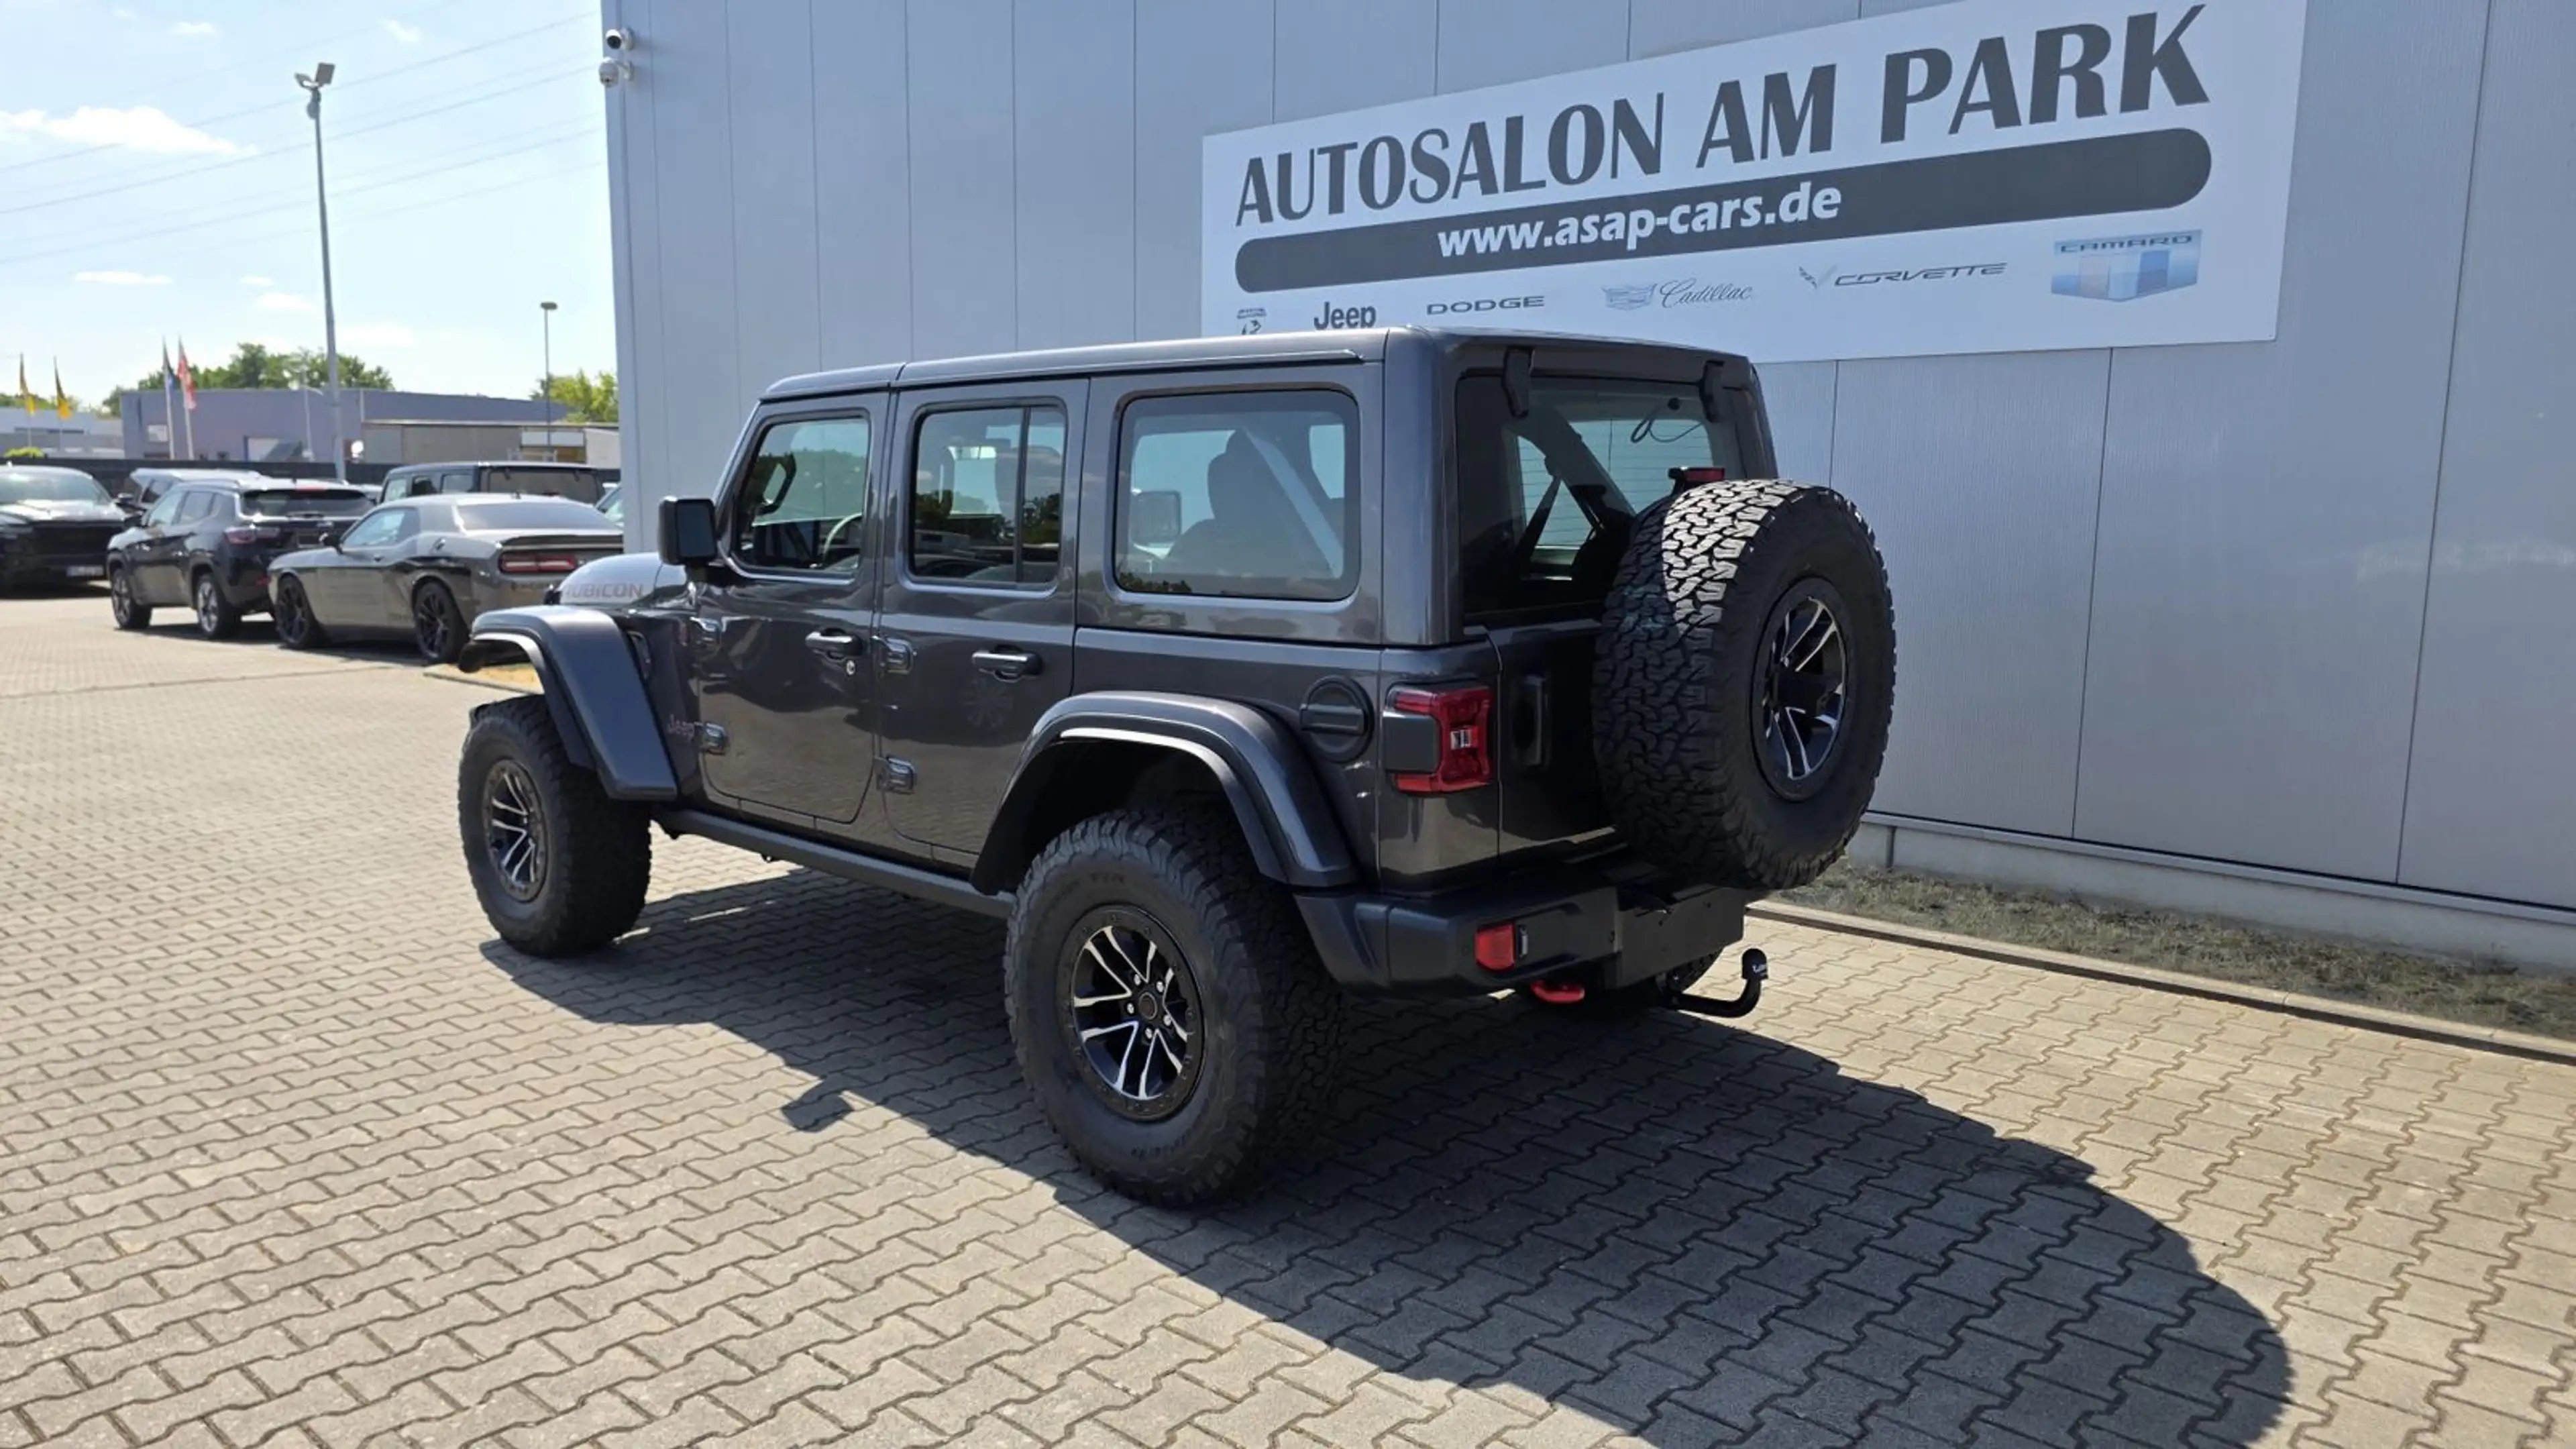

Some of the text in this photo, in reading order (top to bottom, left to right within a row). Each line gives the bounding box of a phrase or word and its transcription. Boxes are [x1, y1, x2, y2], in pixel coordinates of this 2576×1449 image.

[1236, 4, 2210, 227] AUTOSALON AM PARK
[1438, 182, 1841, 257] www.asap-cars.de
[2060, 235, 2193, 253] CAMARO
[1834, 262, 2008, 286] CORVETTE
[1426, 295, 1545, 315] DODGE
[1660, 278, 1753, 309] Cadillac
[1313, 301, 1377, 330] Jeep
